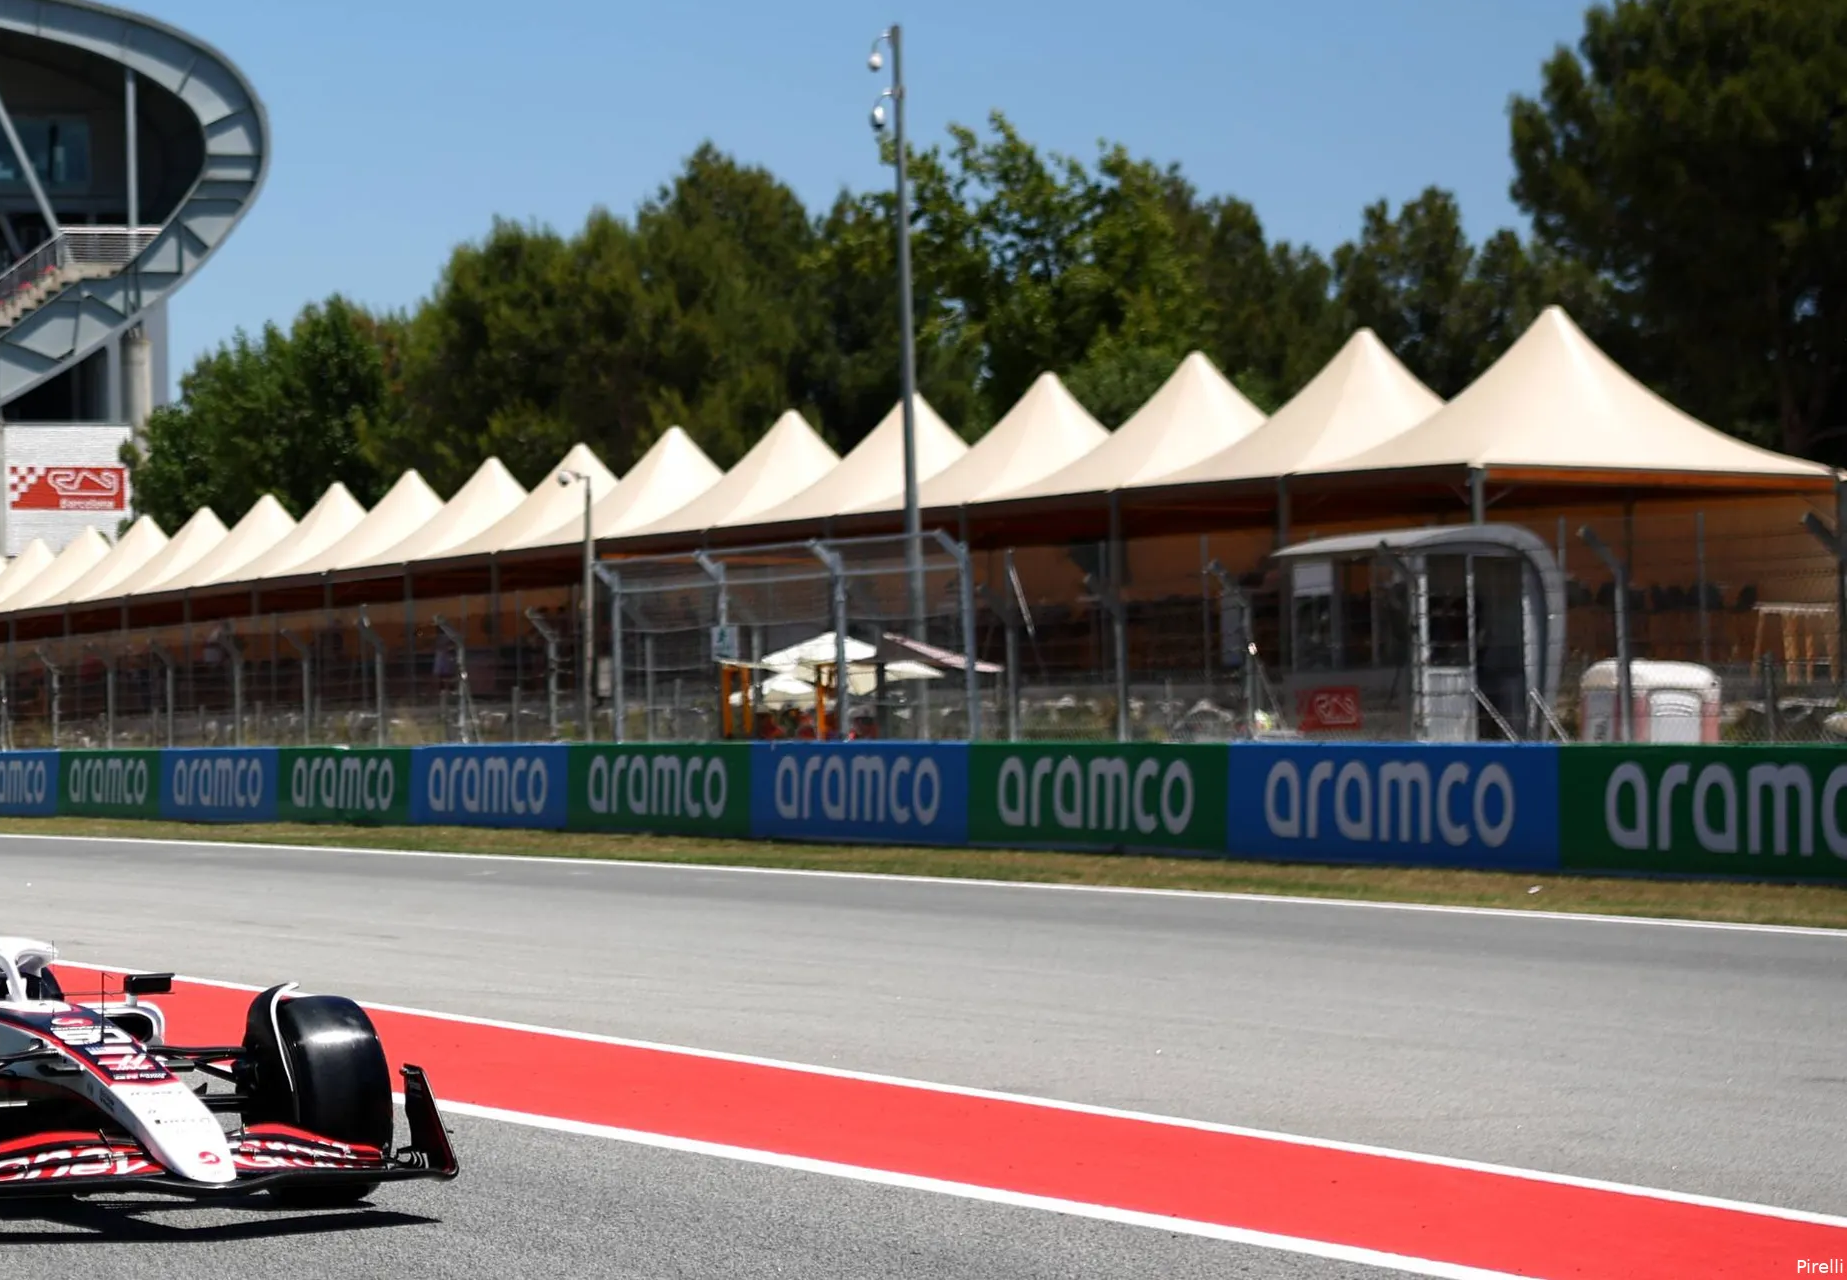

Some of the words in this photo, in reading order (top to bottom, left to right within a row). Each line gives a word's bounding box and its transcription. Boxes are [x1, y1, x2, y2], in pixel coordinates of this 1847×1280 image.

[68, 758, 148, 806] aramco
[172, 758, 263, 807] aramco
[291, 756, 395, 812] aramco
[428, 756, 549, 815] aramco
[587, 754, 728, 820] aramco
[774, 754, 941, 826] aramco
[996, 755, 1195, 835] aramco
[1264, 759, 1516, 848] aramco
